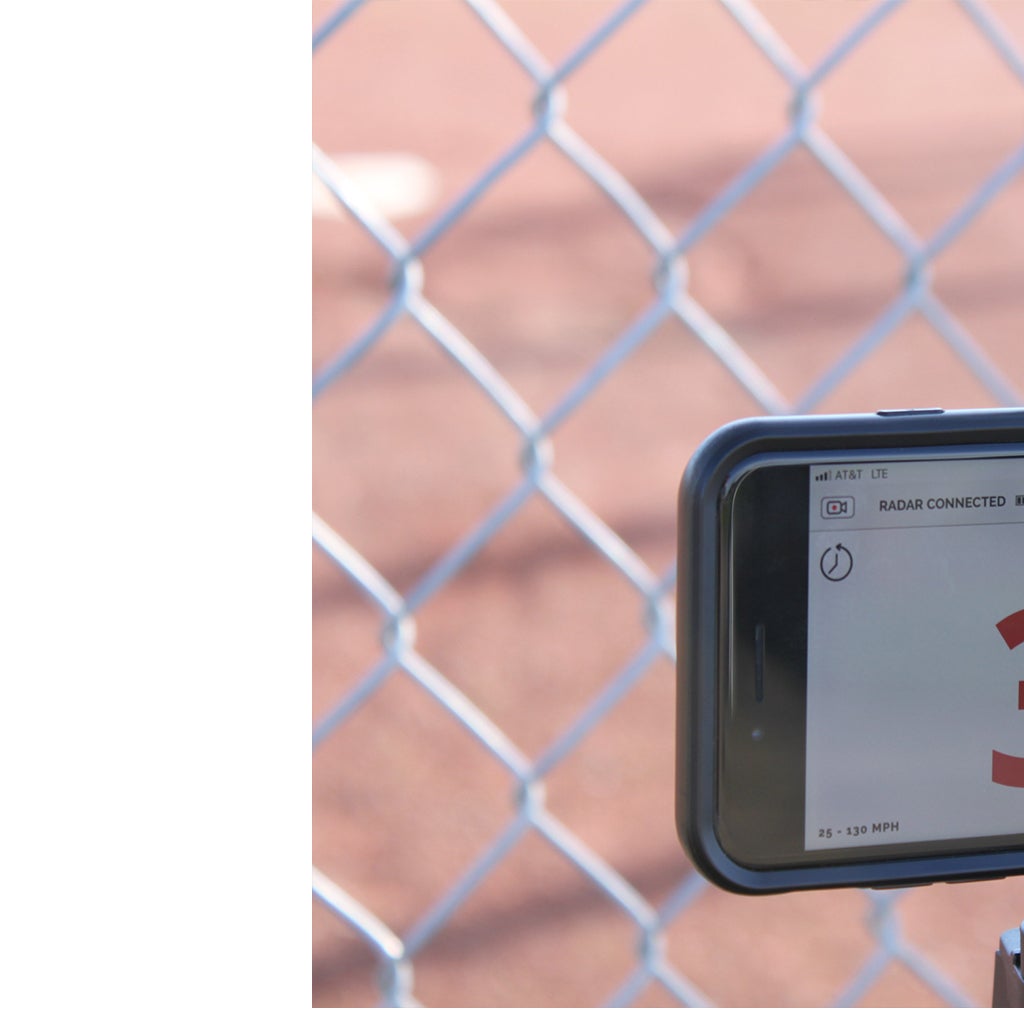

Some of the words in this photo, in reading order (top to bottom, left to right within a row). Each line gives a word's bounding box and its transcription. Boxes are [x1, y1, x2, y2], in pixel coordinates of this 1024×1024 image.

[834, 468, 863, 481] AT&T
[871, 468, 888, 480] LTE
[879, 498, 924, 512] RADAR
[926, 495, 1006, 511] CONNECTED
[818, 828, 833, 839] 25
[846, 824, 868, 837] 130
[871, 821, 899, 834] MPH
